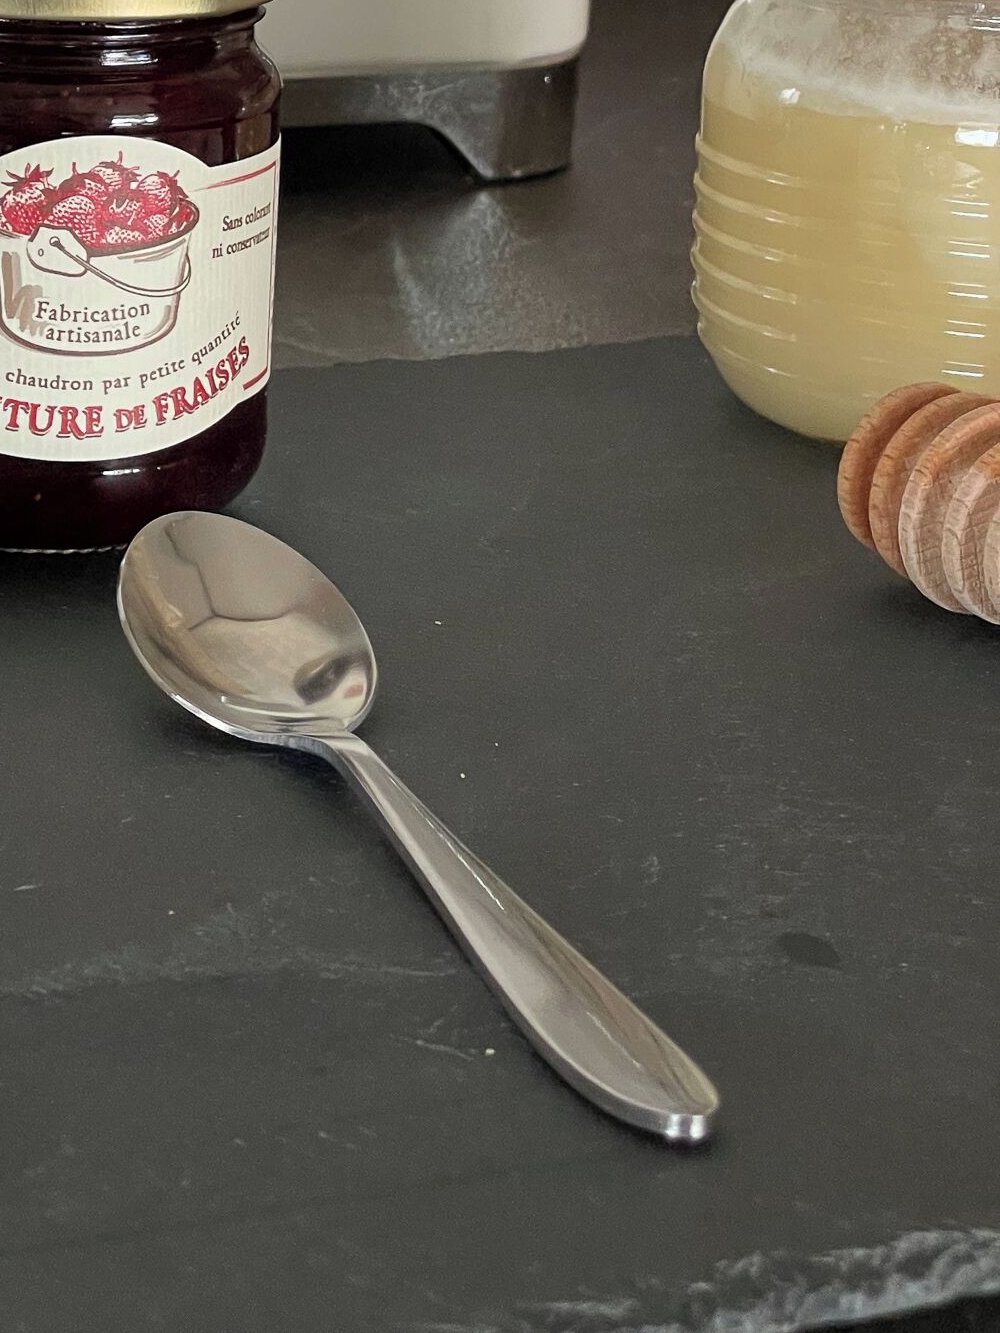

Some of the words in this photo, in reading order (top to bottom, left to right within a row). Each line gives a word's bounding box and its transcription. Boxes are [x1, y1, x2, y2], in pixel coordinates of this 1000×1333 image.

[222, 215, 243, 232] Sans
[212, 243, 224, 259] ni
[36, 303, 150, 323] Fabrication
[45, 322, 141, 343] artisanale
[5, 369, 93, 390] chaudron
[103, 376, 131, 395] par
[139, 357, 185, 388] petite
[191, 310, 241, 365] quantité
[114, 404, 147, 432] DE
[152, 336, 250, 426] FRAISES
